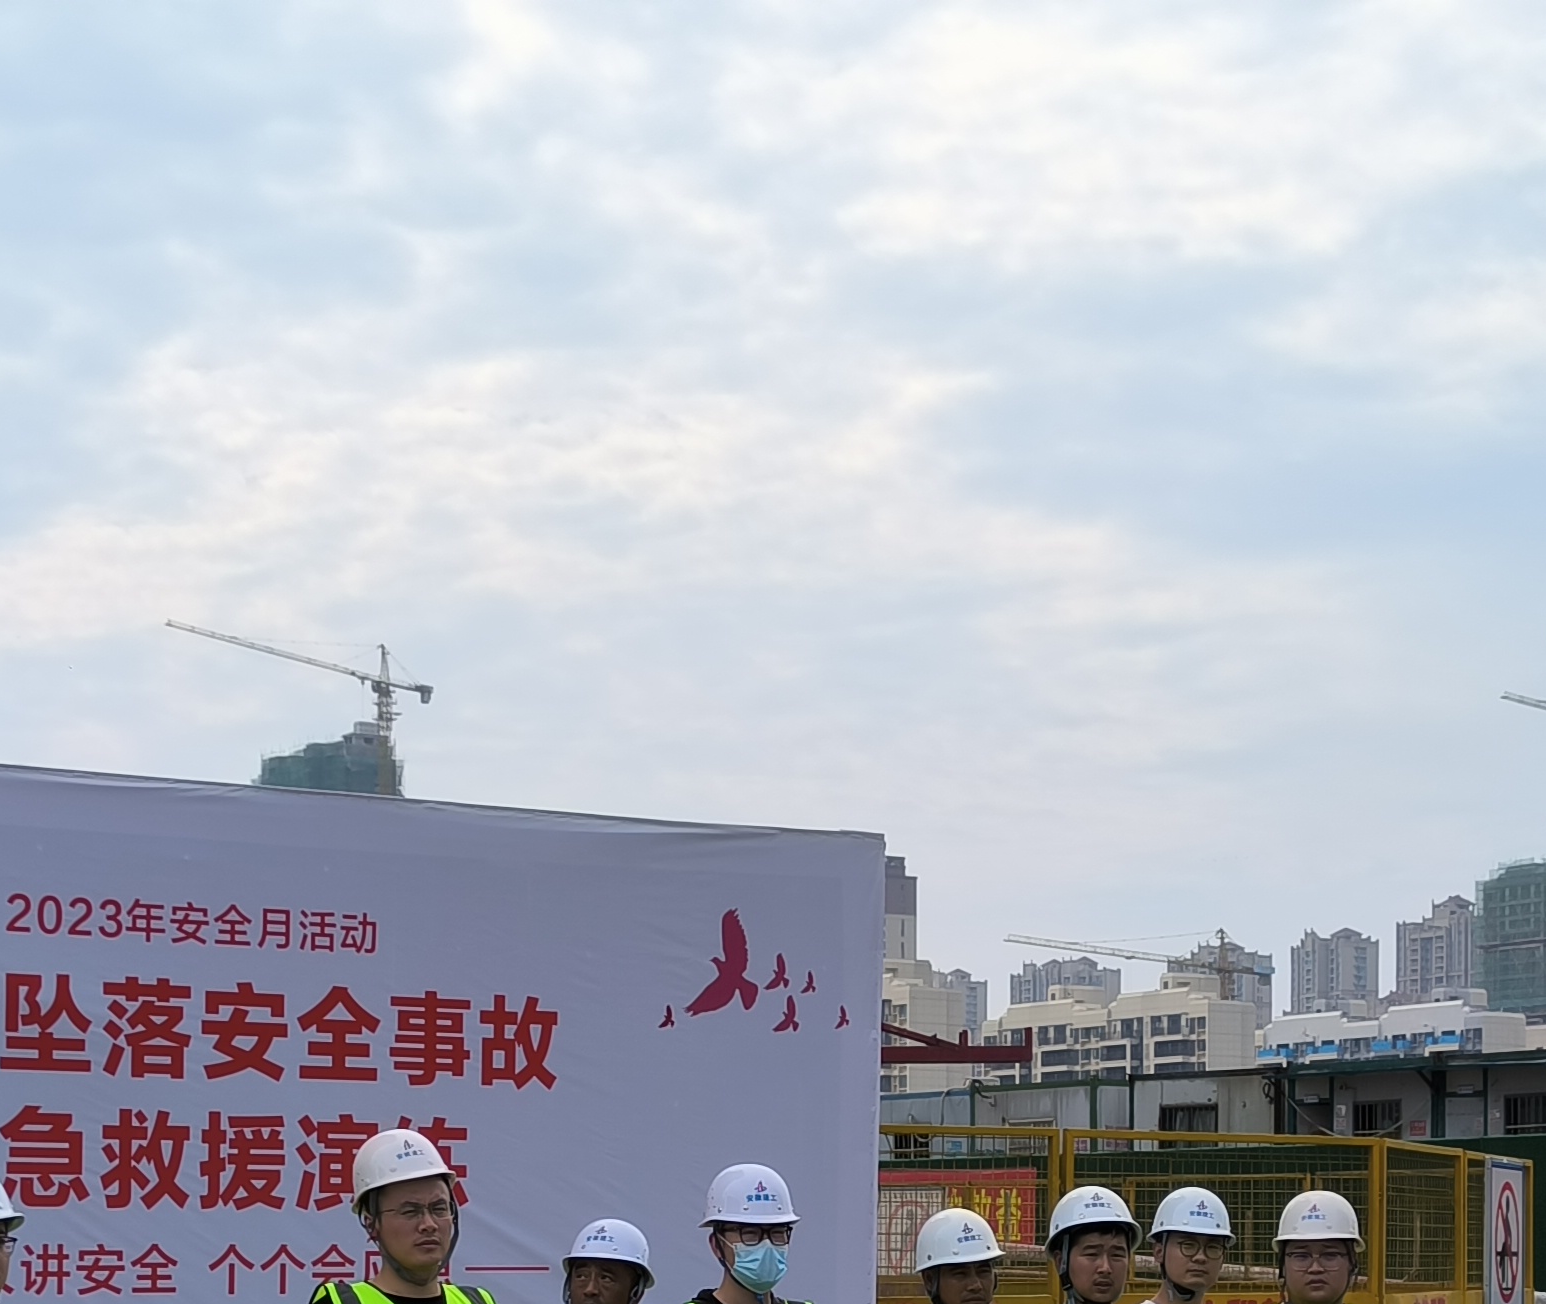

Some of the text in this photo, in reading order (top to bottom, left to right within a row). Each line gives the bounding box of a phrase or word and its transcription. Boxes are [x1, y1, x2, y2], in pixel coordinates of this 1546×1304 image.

[5, 893, 379, 955] 2023年安全月活动
